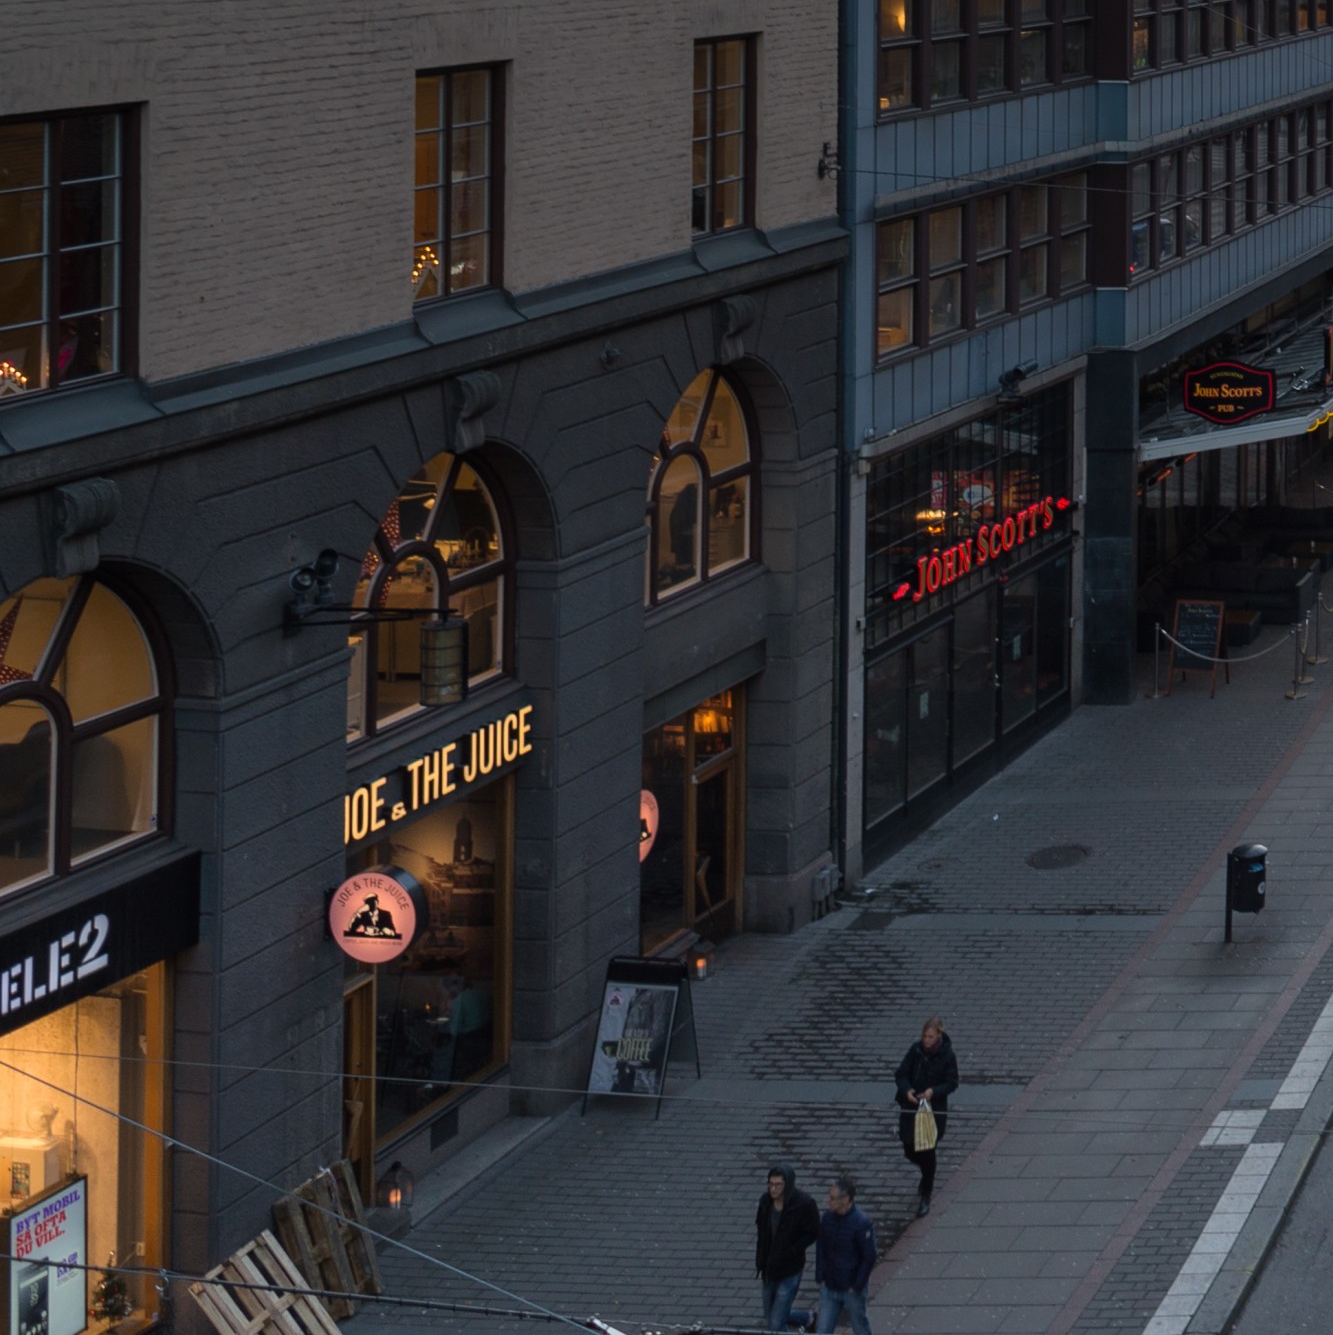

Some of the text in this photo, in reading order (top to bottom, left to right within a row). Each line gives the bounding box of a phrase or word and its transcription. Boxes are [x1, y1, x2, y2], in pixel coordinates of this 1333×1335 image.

[1193, 382, 1219, 397] JOHN
[1217, 404, 1235, 413] PUB
[913, 496, 1054, 602] JOHN SCOTT'S
[344, 704, 533, 844] JOE & THE JUICE
[337, 877, 411, 911] JOE & THE JUICE
[0, 913, 109, 1016] ELE2
[616, 1037, 653, 1062] COFFEE
[16, 1190, 80, 1234] BYT MOBIL
[16, 1209, 67, 1248] SÅ OFTA
[16, 1242, 33, 1262] DU
[36, 1226, 65, 1249] VILL.
